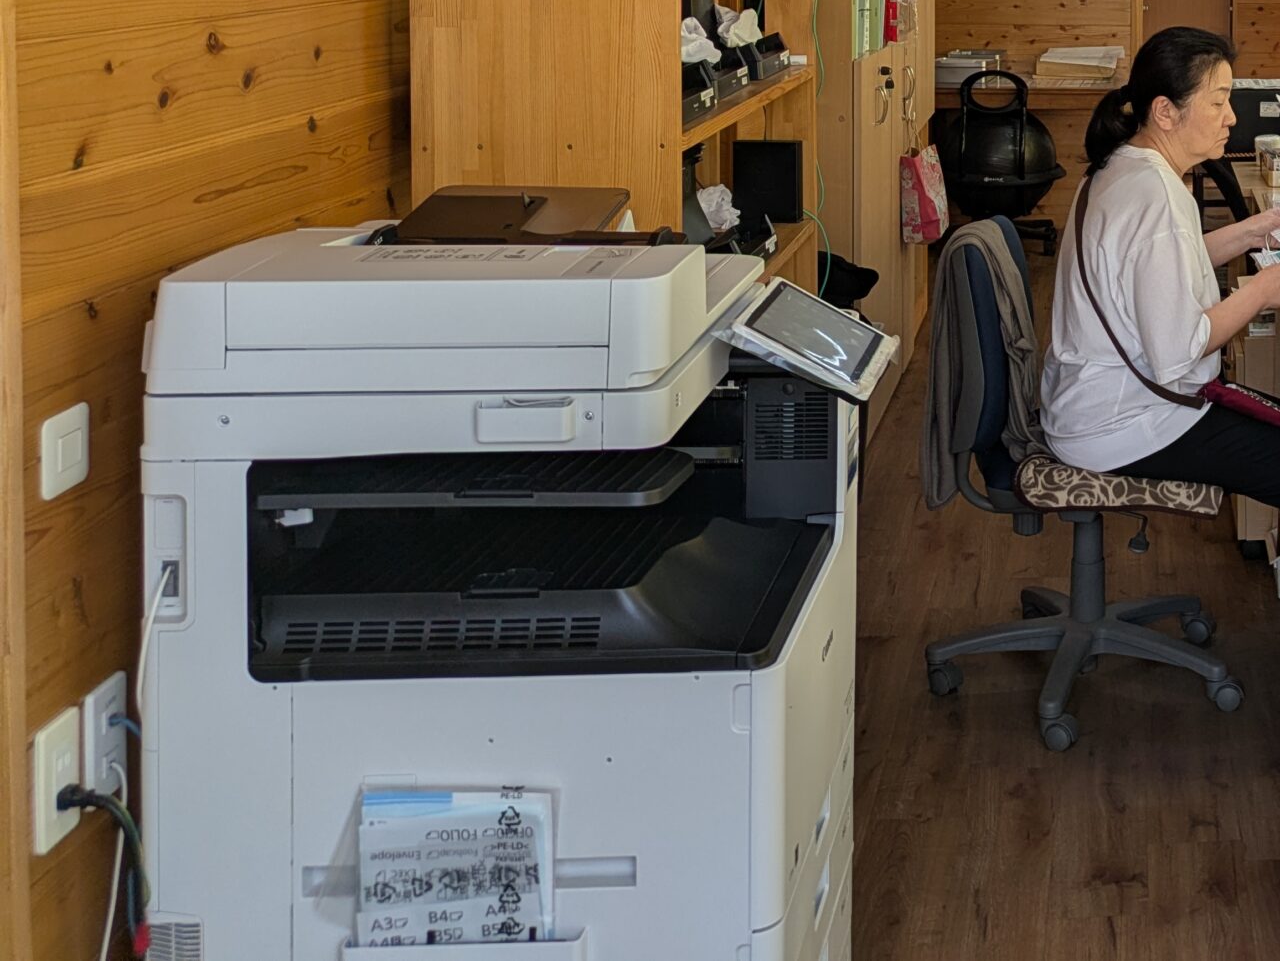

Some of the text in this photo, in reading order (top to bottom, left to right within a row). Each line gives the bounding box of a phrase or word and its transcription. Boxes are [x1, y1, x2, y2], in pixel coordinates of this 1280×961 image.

[440, 828, 478, 842] FOLIO
[370, 850, 422, 862] Envelope
[371, 917, 394, 932] A3
[428, 910, 449, 925] B4
